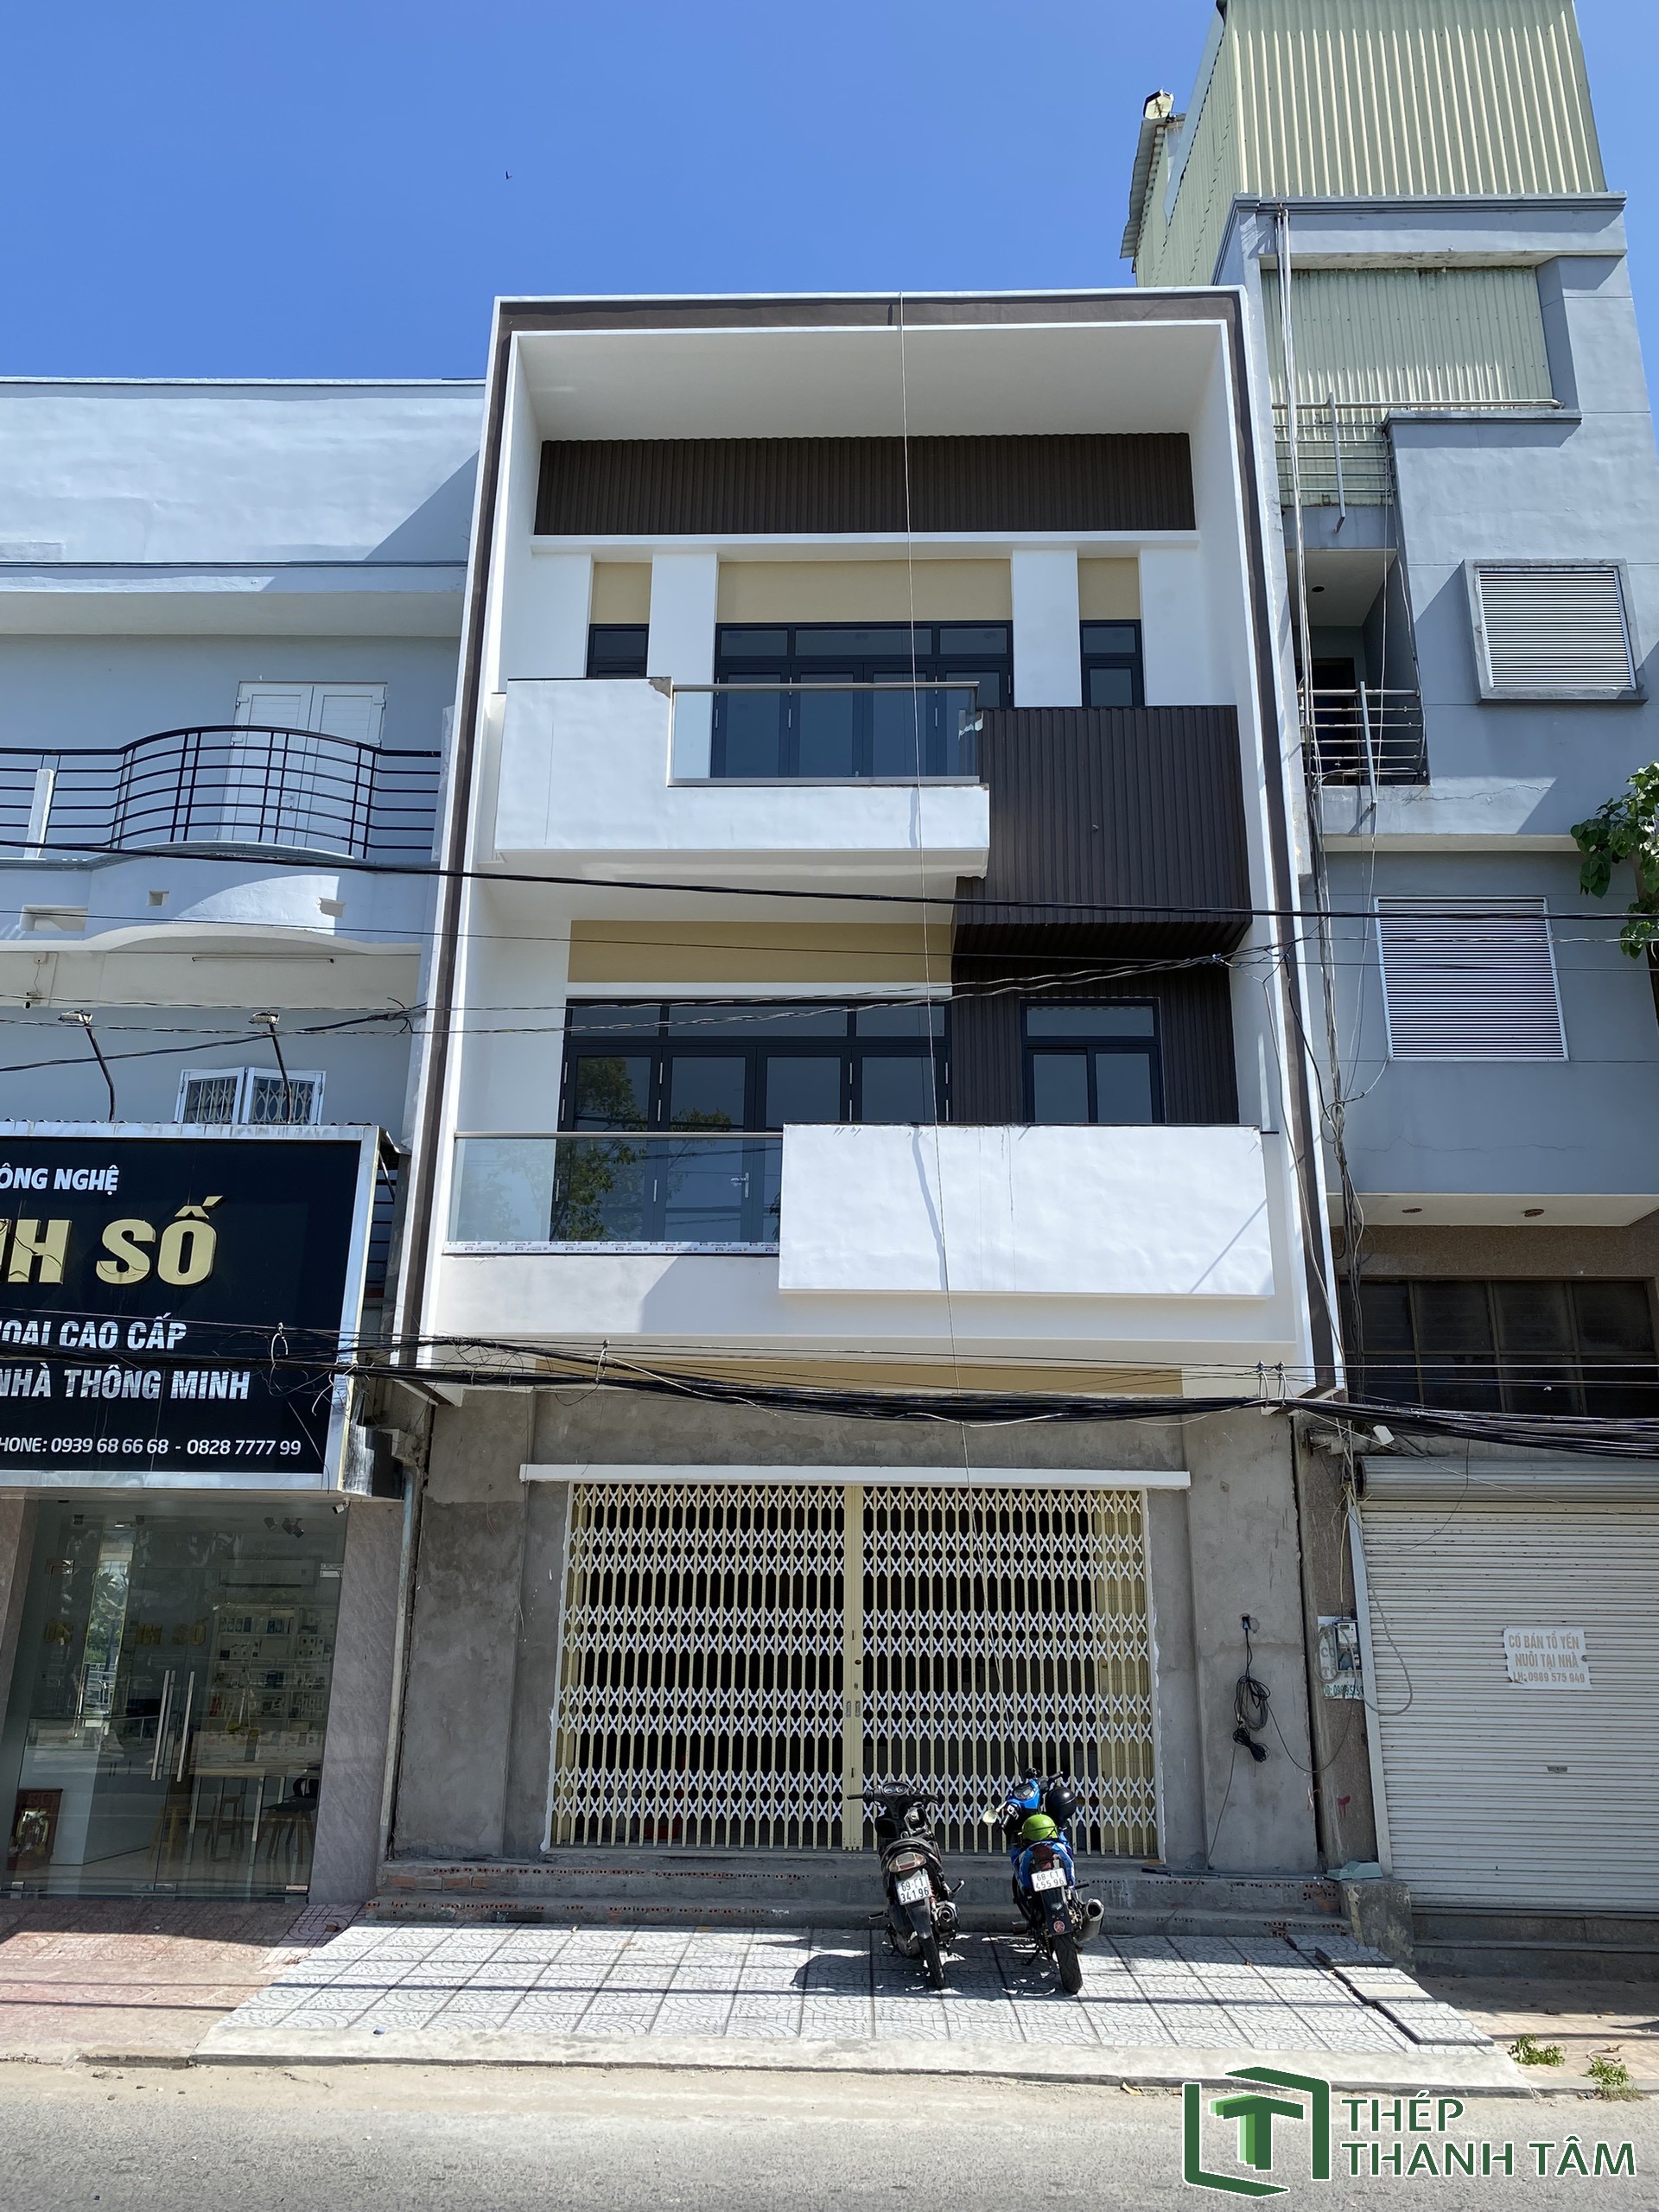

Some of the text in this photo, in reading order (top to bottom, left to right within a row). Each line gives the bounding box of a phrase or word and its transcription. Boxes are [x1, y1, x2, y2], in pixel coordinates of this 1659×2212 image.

[54, 1164, 119, 1196] NGHỆ
[95, 1196, 225, 1286] SỐ
[59, 1320, 118, 1350] CAO
[126, 1313, 188, 1351] CẤP
[63, 1363, 162, 1400] THÔNG
[170, 1371, 251, 1401] MINH
[50, 1437, 93, 1453] 0939
[96, 1438, 118, 1453] 68
[121, 1438, 143, 1454] 66
[146, 1439, 168, 1455] 68
[187, 1440, 231, 1456] 0828
[235, 1440, 275, 1456] 7777
[279, 1440, 302, 1456] 99
[1509, 1632, 1522, 1649] CÓ
[1523, 1632, 1544, 1649] BÁN
[1560, 1632, 1580, 1649] YẾN
[1515, 1651, 1579, 1670] NUÔI TẠI NHÀ
[1528, 1671, 1549, 1682] 0989
[1551, 1672, 1567, 1682] 575
